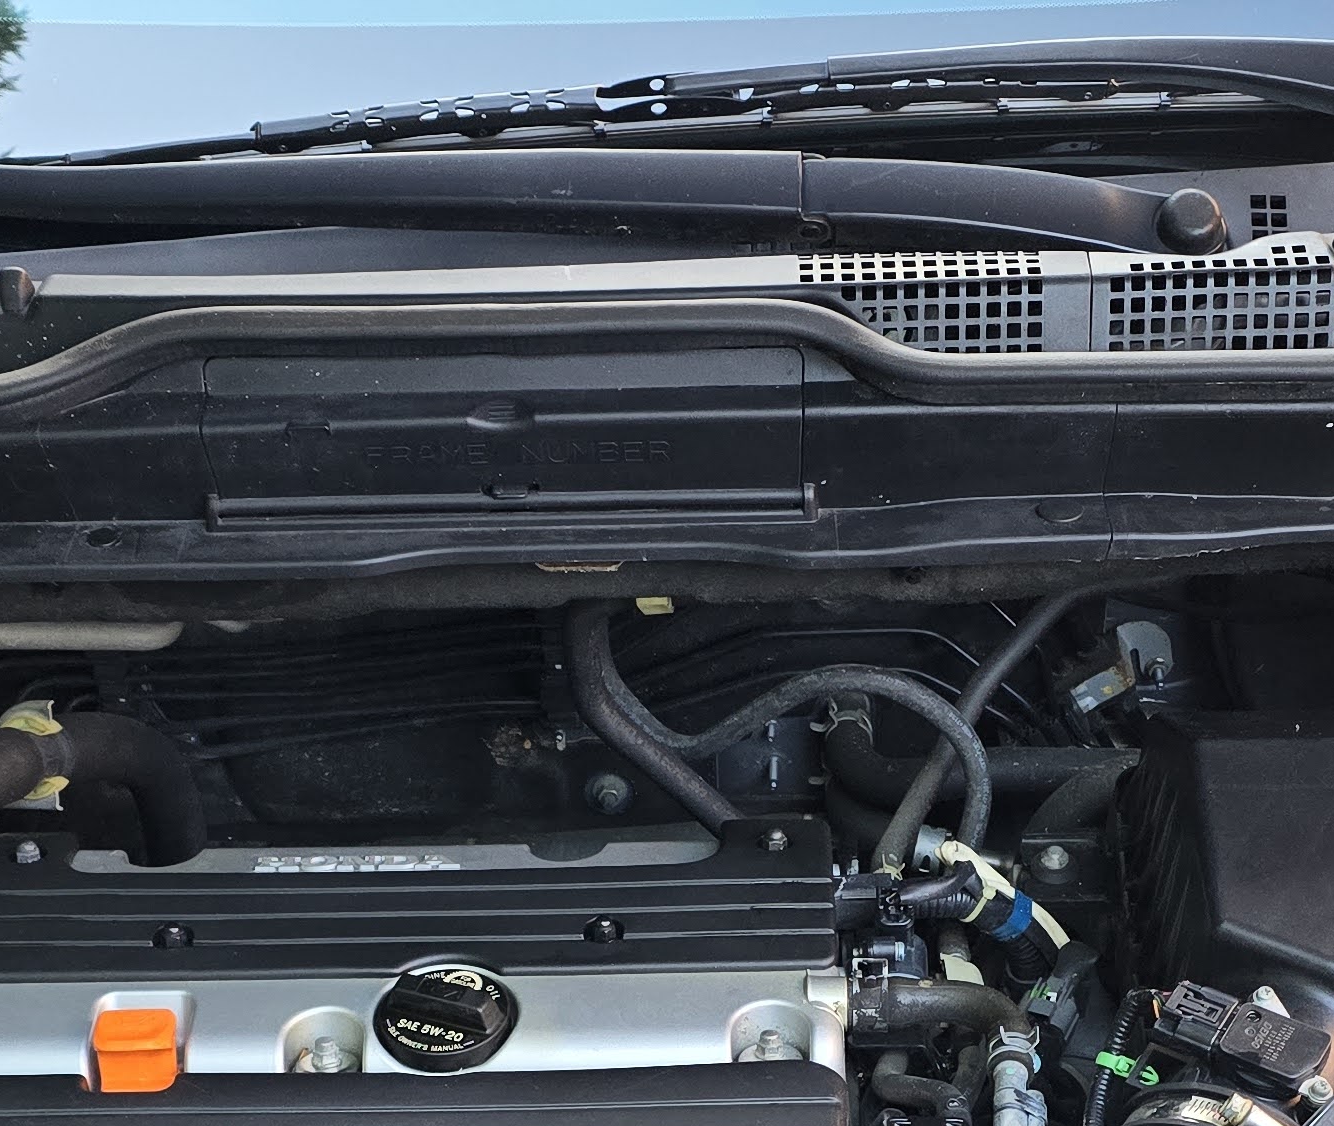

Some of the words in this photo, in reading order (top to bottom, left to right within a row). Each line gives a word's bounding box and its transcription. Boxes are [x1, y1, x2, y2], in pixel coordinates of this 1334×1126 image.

[366, 443, 489, 464] FRAME
[521, 440, 671, 463] NUMBER
[253, 855, 461, 873] HONDA
[485, 984, 501, 1000] OIL
[396, 1018, 421, 1032] SAE
[420, 1023, 465, 1042] 5W-20
[430, 1043, 465, 1052] MANUAL
